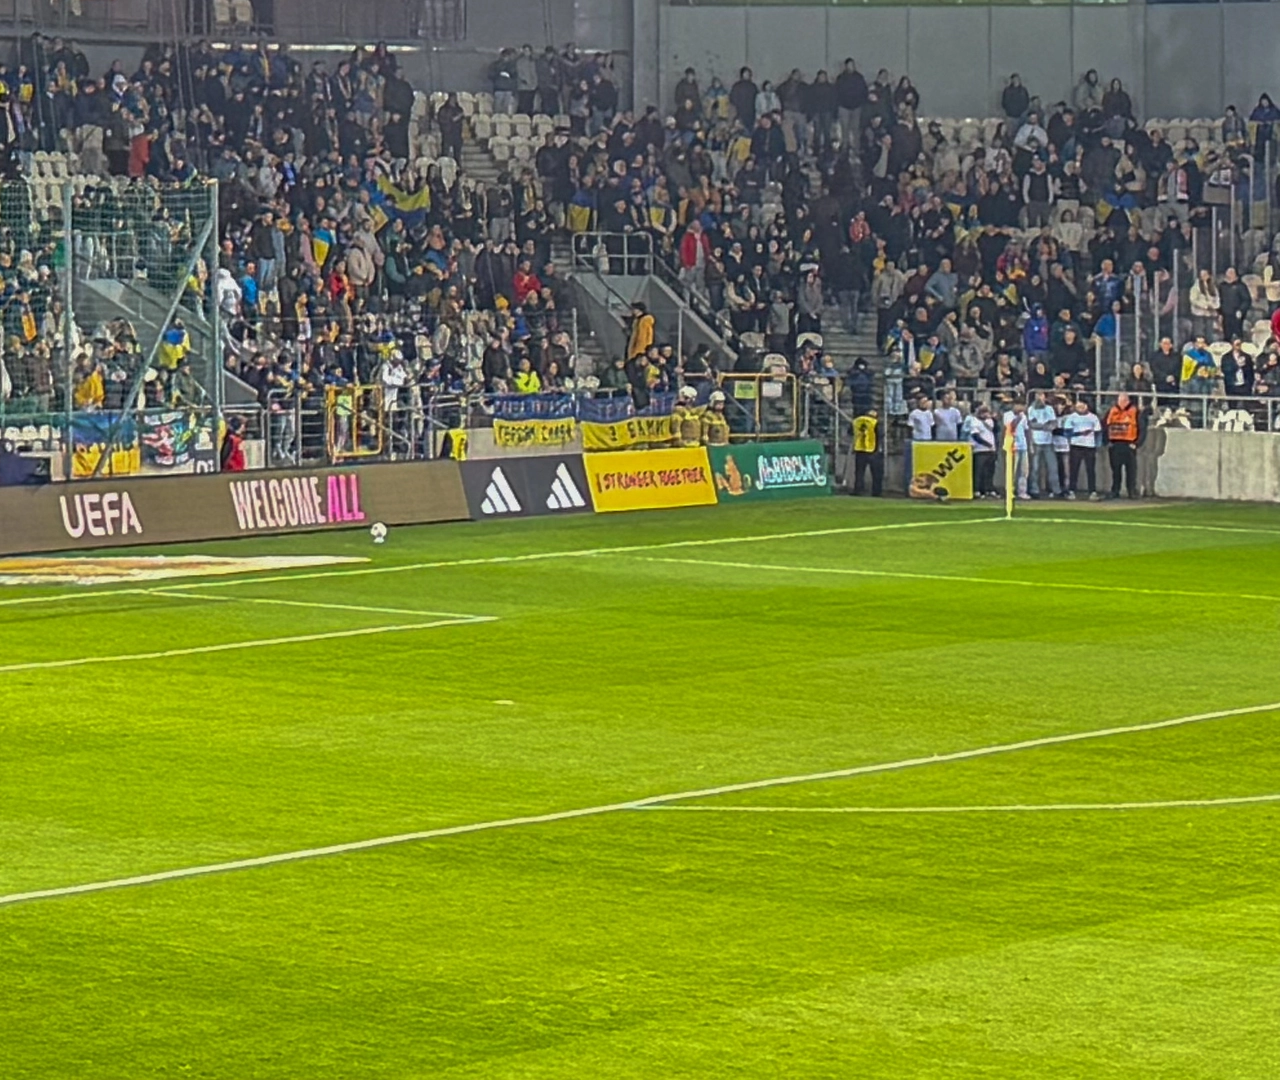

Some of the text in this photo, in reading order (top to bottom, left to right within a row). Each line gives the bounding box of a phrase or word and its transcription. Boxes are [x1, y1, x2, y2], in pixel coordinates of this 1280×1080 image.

[60, 491, 143, 538] UEFA
[229, 474, 365, 529] WELCOME ALL
